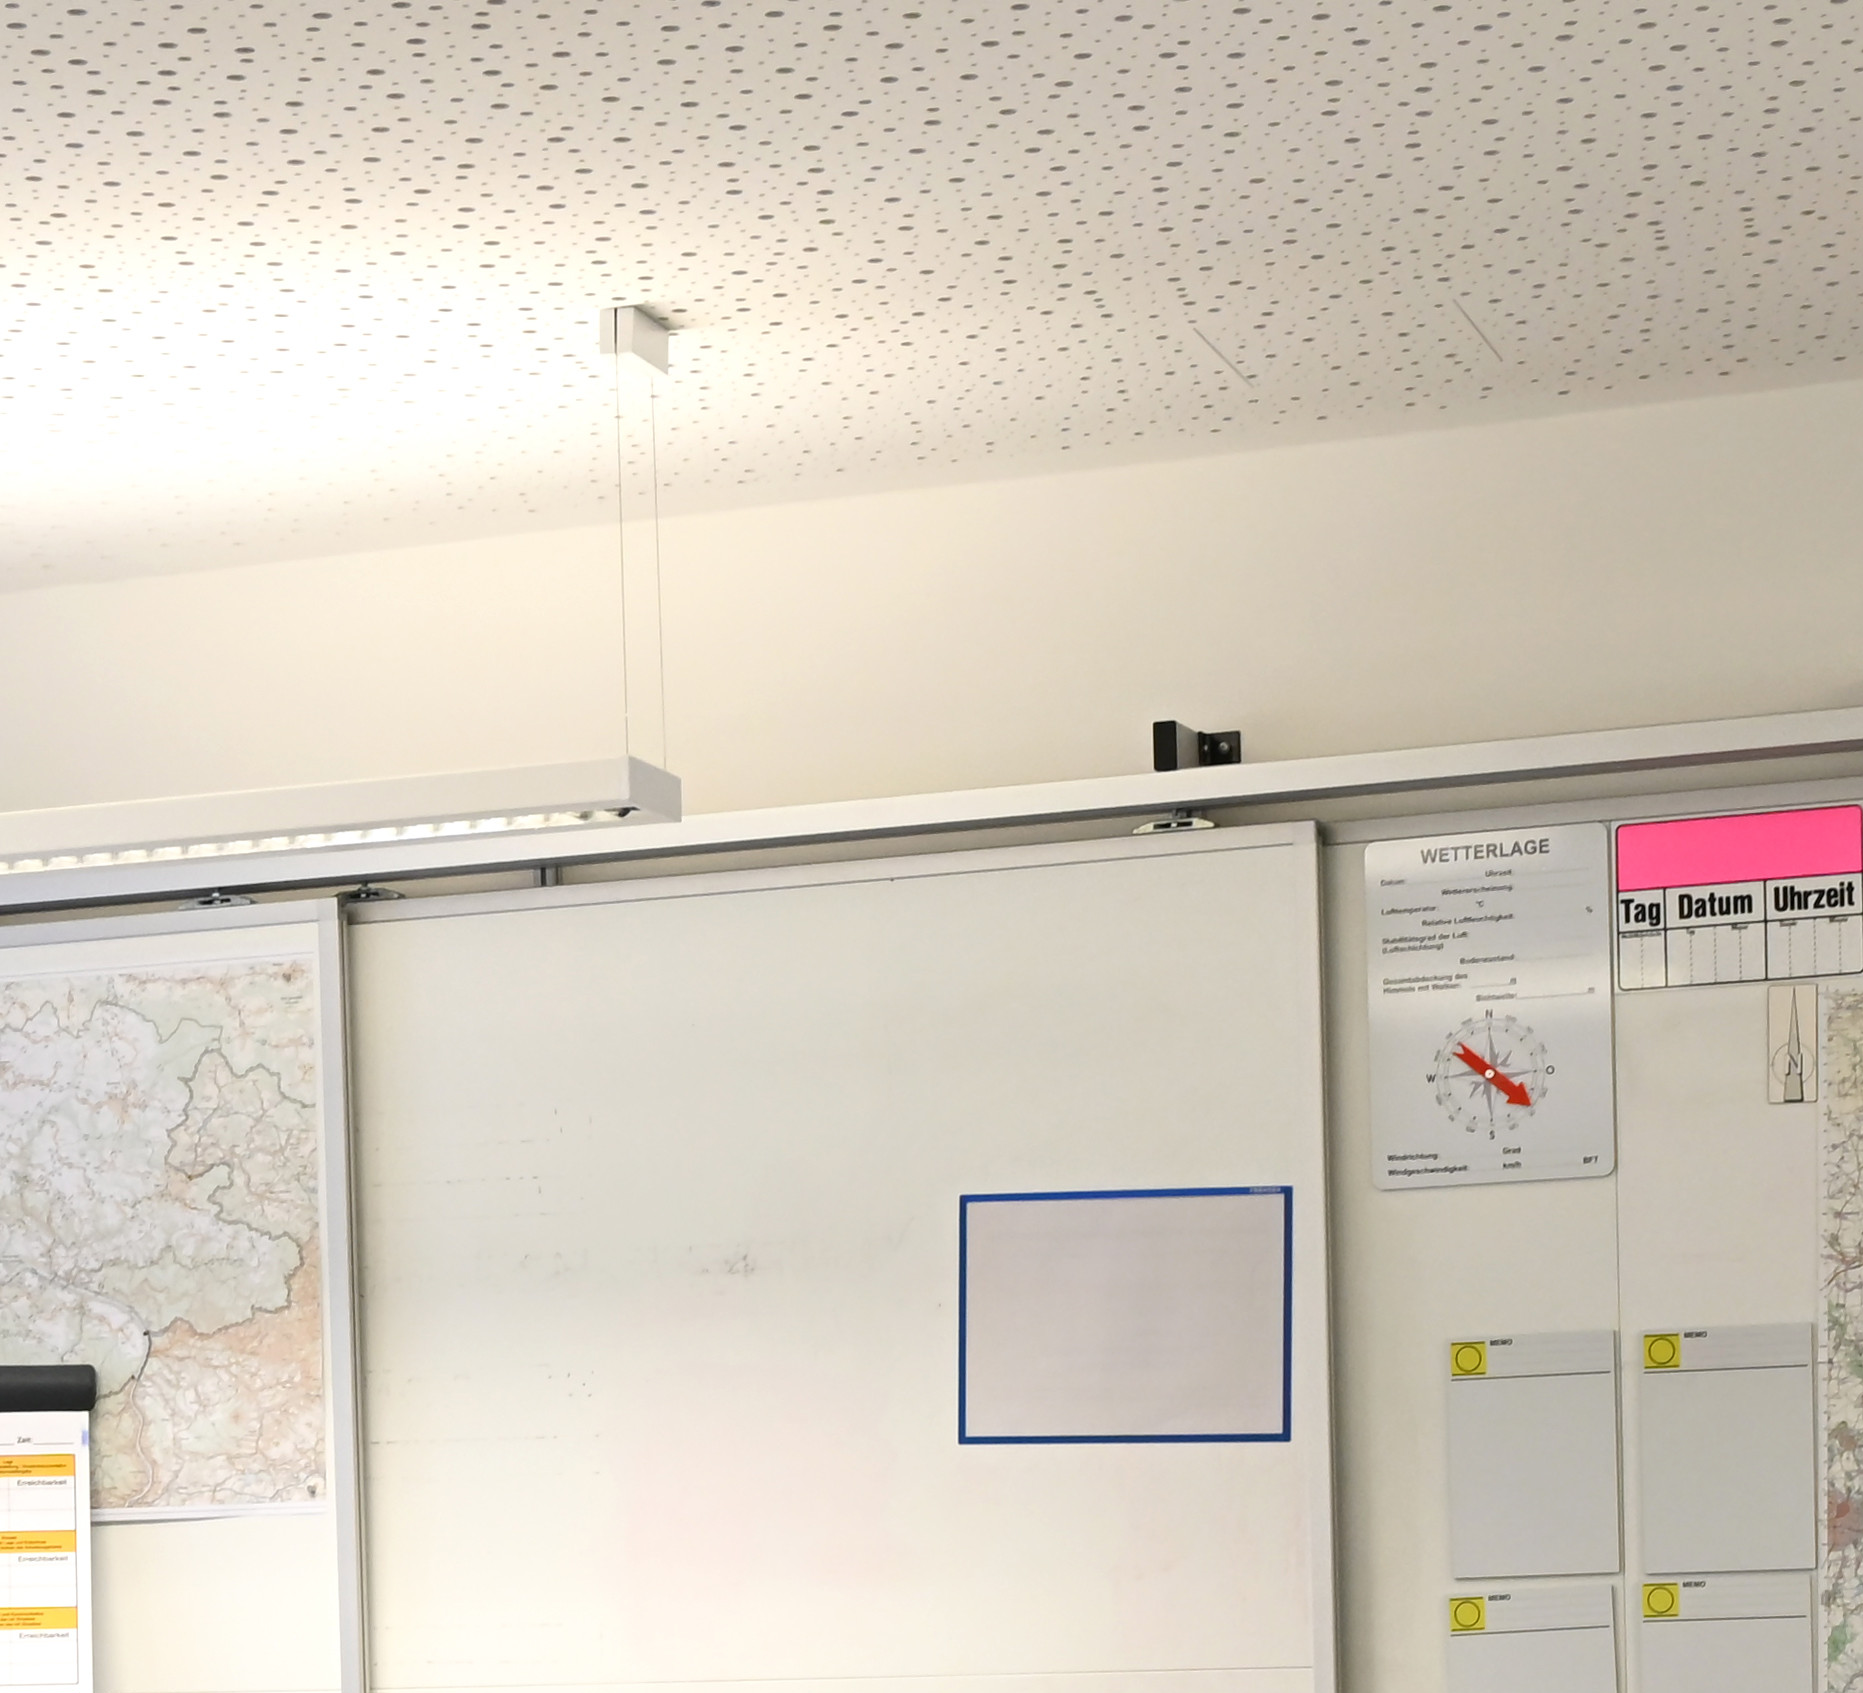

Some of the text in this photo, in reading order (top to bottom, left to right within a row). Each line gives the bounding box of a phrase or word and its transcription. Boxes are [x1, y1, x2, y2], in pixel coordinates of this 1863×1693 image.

[1421, 838, 1551, 864] WETTERLAGE
[1678, 892, 1752, 919] Datum
[1774, 882, 1855, 912] Uhrzeit
[1620, 899, 1661, 927] Tag
[1485, 1010, 1493, 1018] N
[1426, 1065, 1554, 1084] W O
[1489, 1130, 1495, 1140] S
